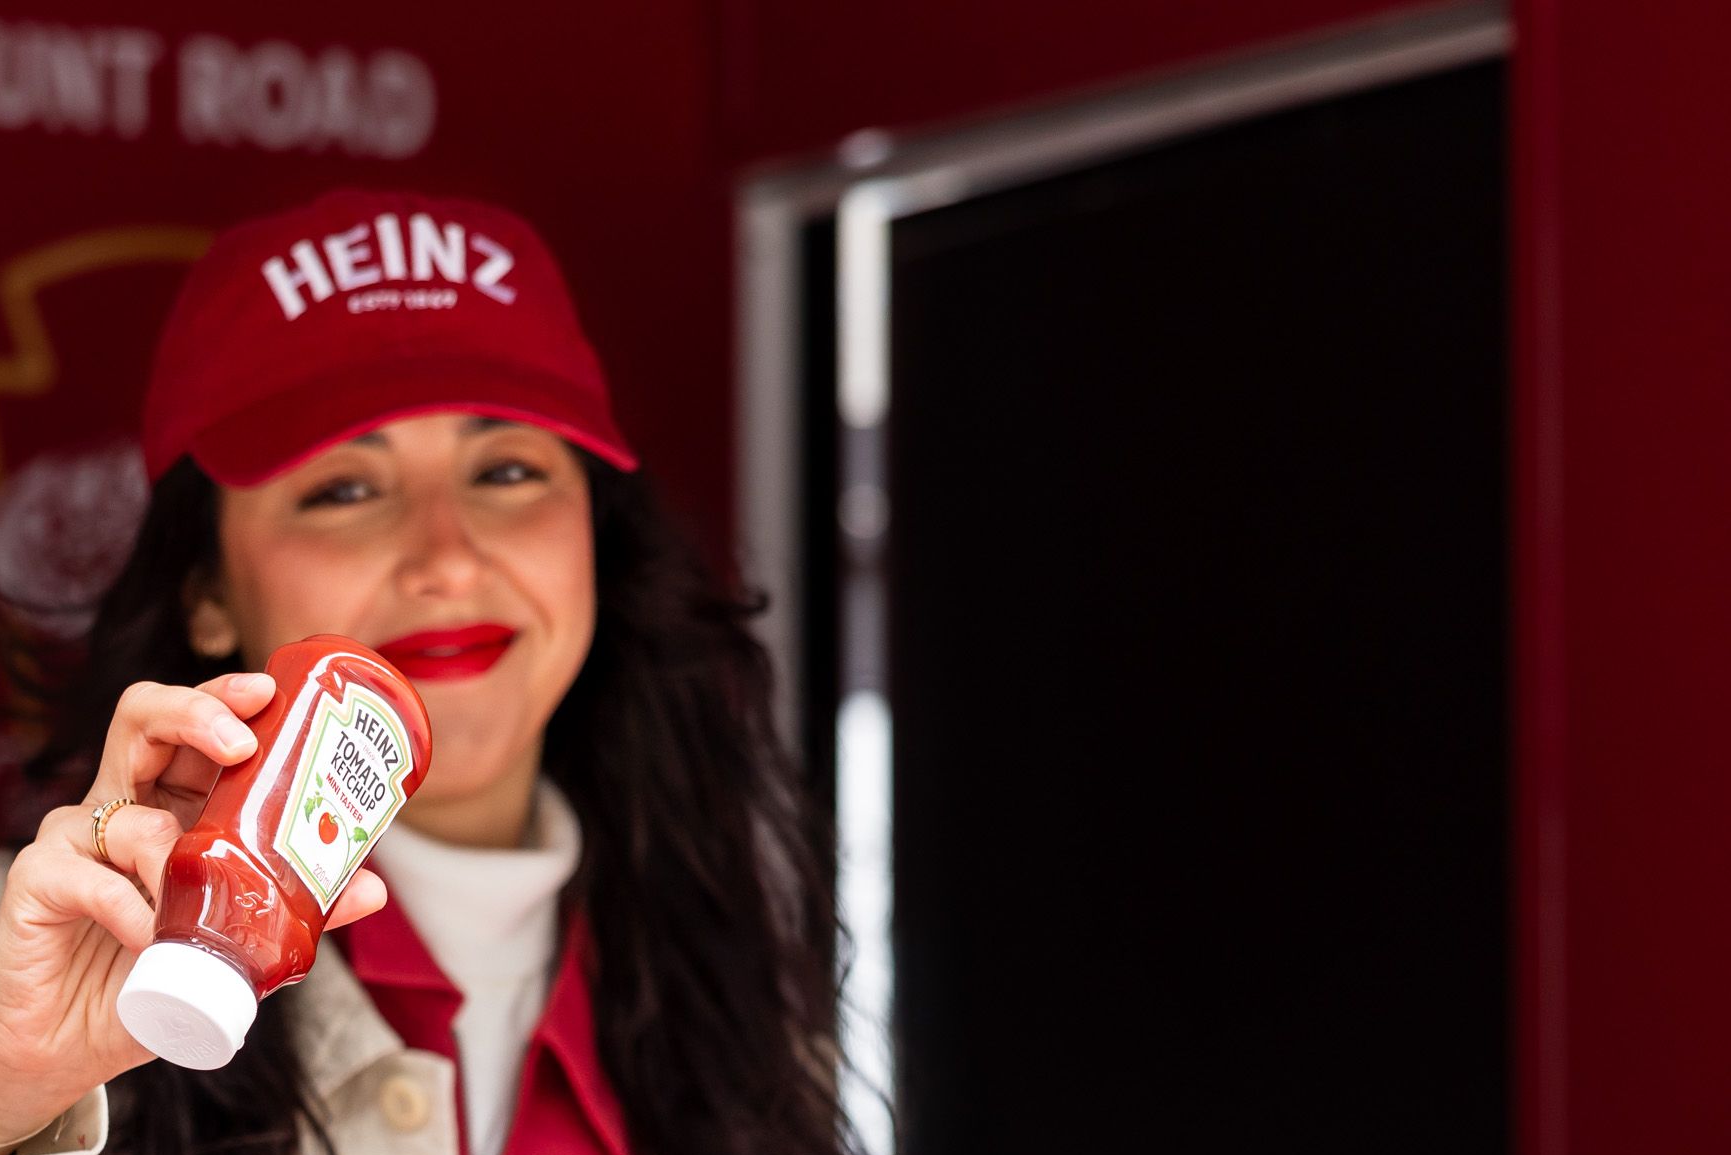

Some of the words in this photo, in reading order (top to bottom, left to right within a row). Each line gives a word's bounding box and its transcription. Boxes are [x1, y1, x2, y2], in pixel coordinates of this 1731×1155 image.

[178, 32, 437, 160] ROAD
[261, 212, 517, 322] HEINZ
[337, 730, 386, 802] TOMATO
[354, 708, 399, 772] HEINZ
[326, 772, 341, 795] MINI
[340, 792, 363, 823] TASTER
[331, 751, 376, 811] KETCHUP
